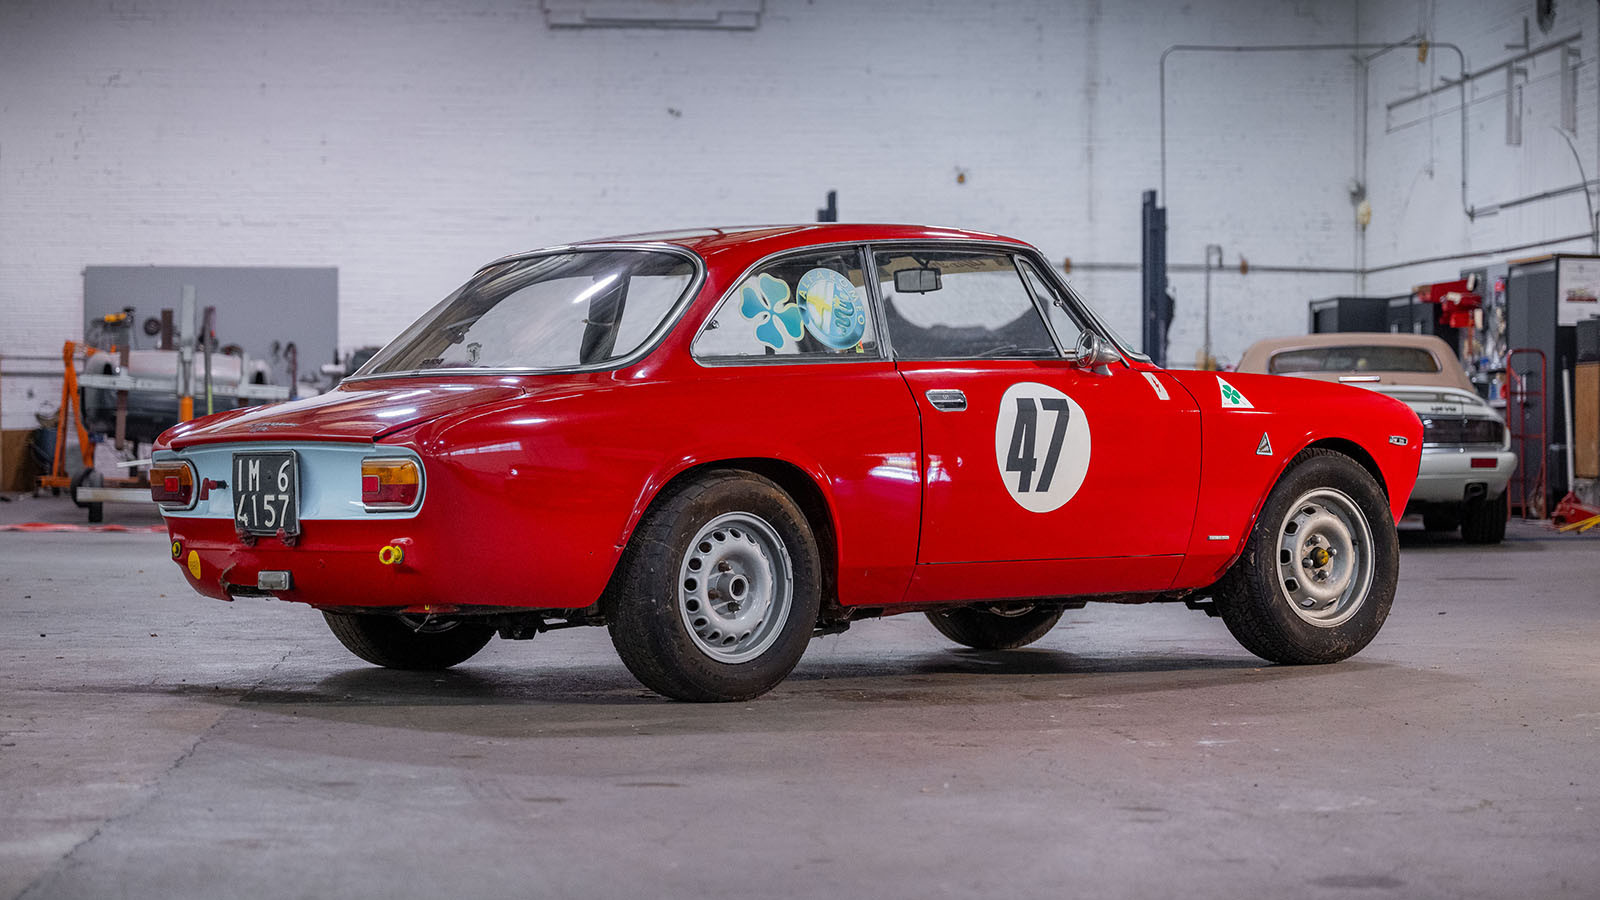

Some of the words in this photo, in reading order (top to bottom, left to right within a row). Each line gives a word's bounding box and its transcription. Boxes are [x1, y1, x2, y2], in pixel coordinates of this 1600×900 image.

[798, 271, 825, 300] ALFA
[829, 271, 865, 326] ROMEO
[1006, 397, 1070, 493] 47
[277, 459, 290, 492] 6
[237, 494, 290, 528] 4157
